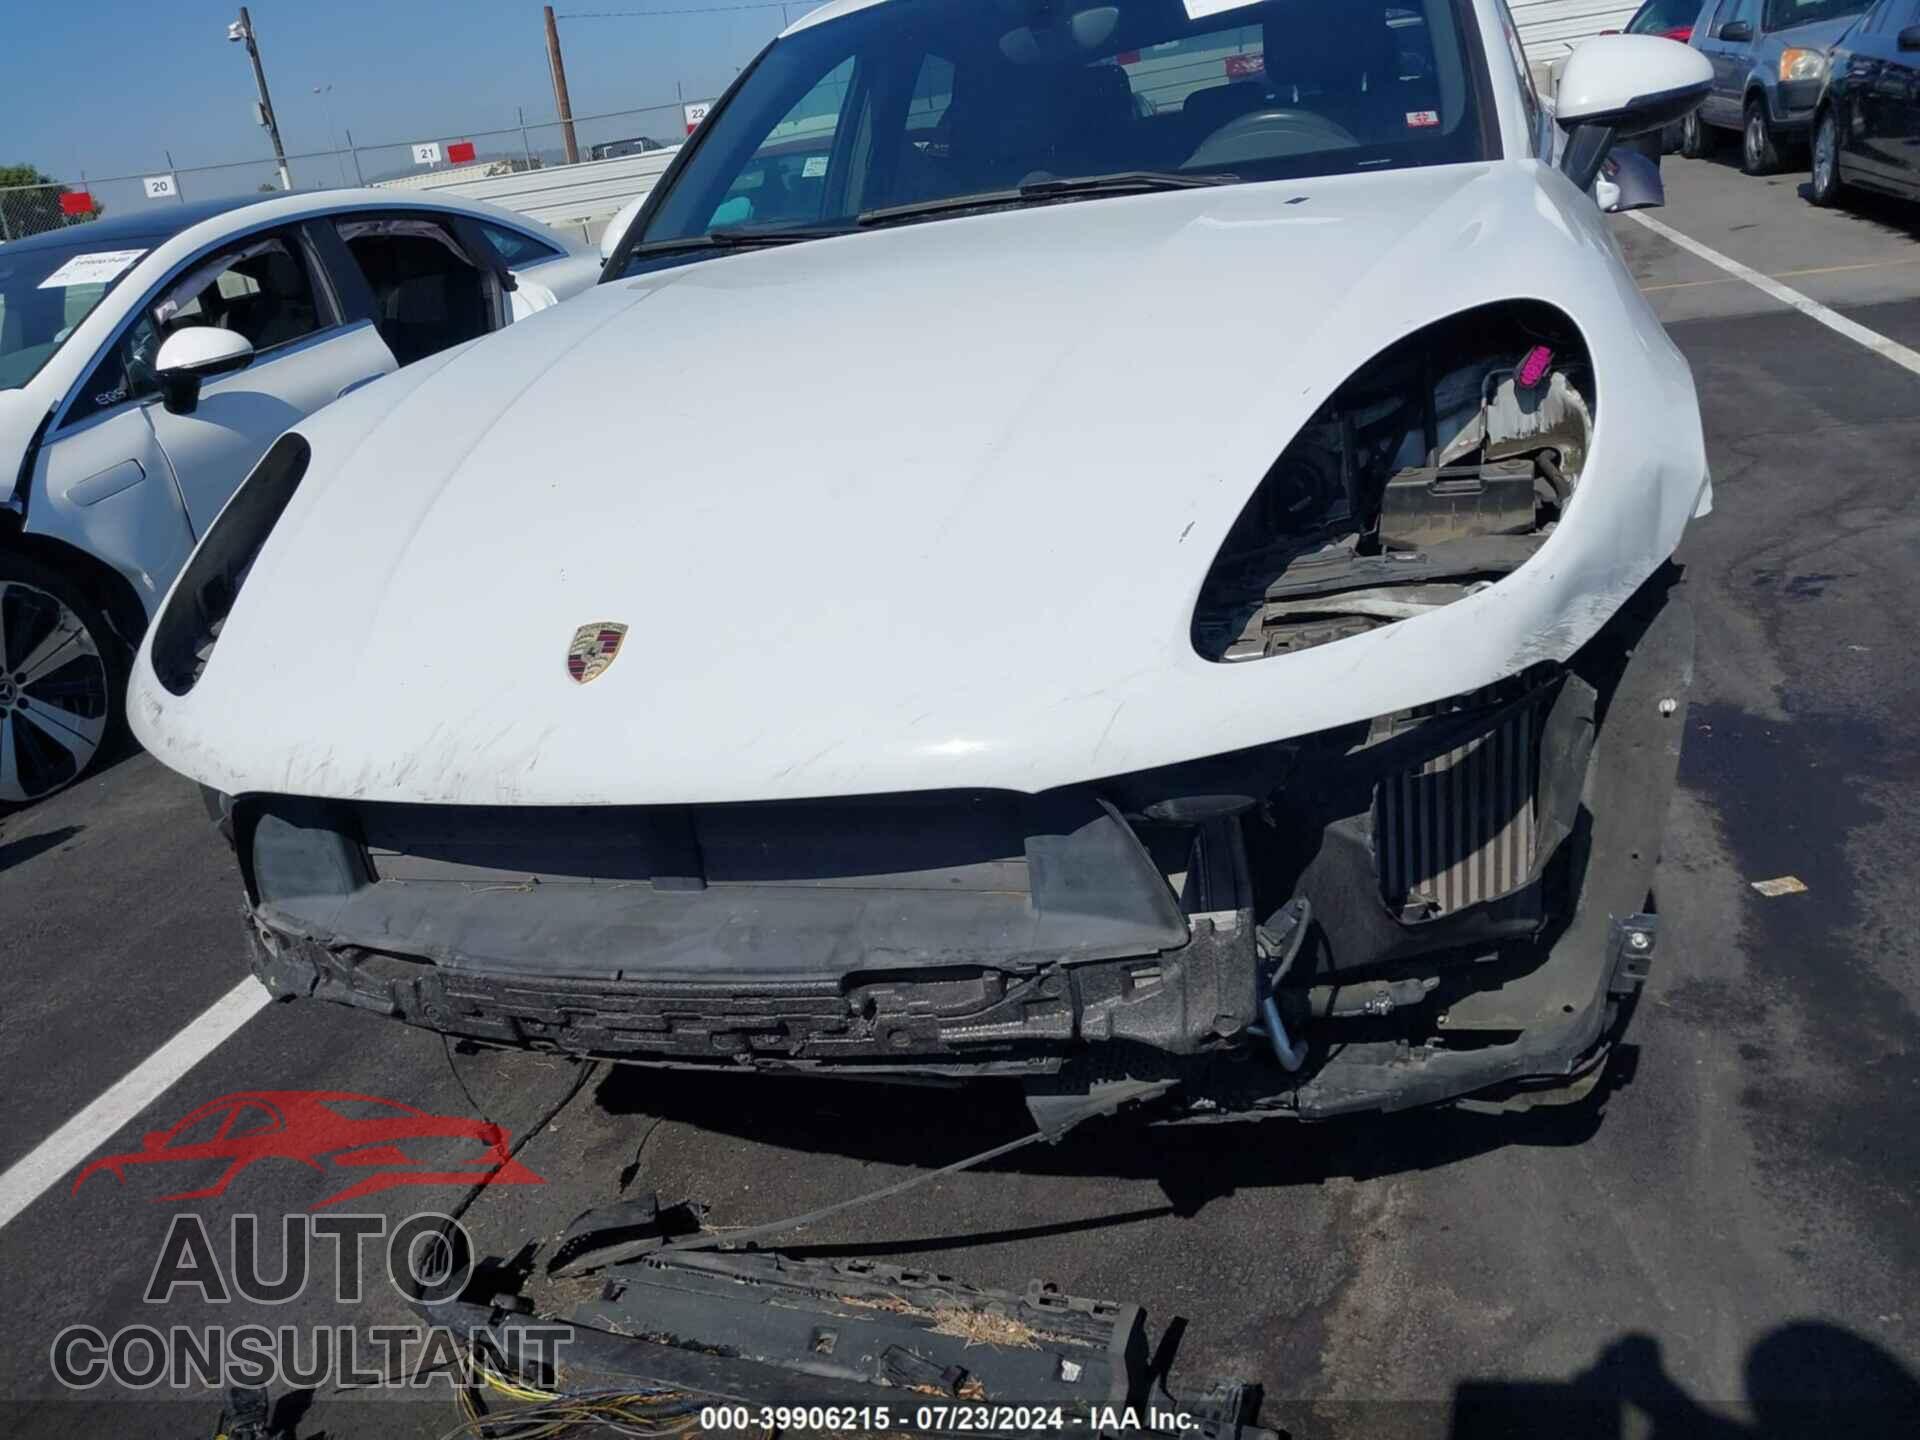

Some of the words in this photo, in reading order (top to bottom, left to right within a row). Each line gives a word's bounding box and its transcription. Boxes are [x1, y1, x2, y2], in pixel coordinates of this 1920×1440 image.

[691, 108, 705, 119] 22
[420, 148, 434, 159] 21
[151, 181, 169, 193] 20
